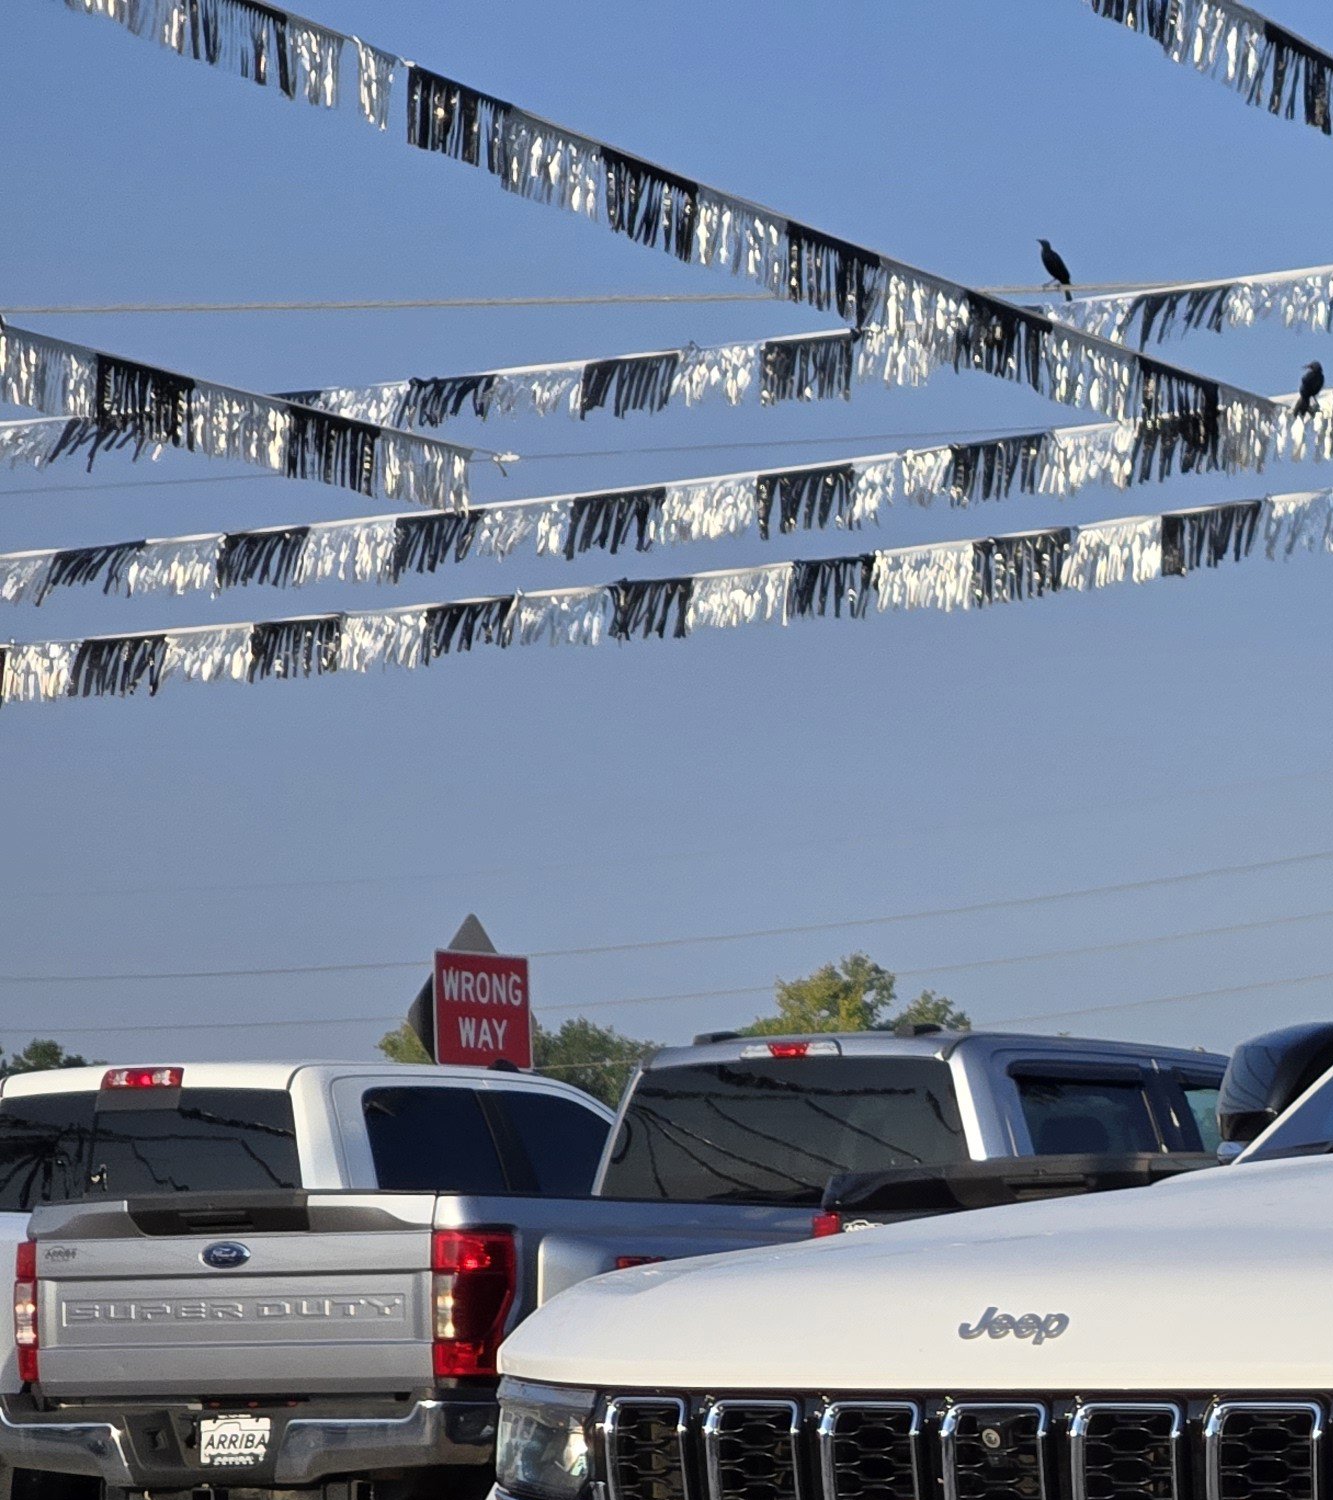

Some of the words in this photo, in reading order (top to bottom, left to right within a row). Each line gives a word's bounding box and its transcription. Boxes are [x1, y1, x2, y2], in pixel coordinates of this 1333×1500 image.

[442, 967, 523, 1007] WRONG
[458, 1016, 508, 1051] WAY
[67, 1301, 244, 1320] SUPER
[255, 1297, 402, 1318] DUTY
[958, 1306, 1070, 1346] Jeep
[205, 1433, 268, 1450] ARRIBA
